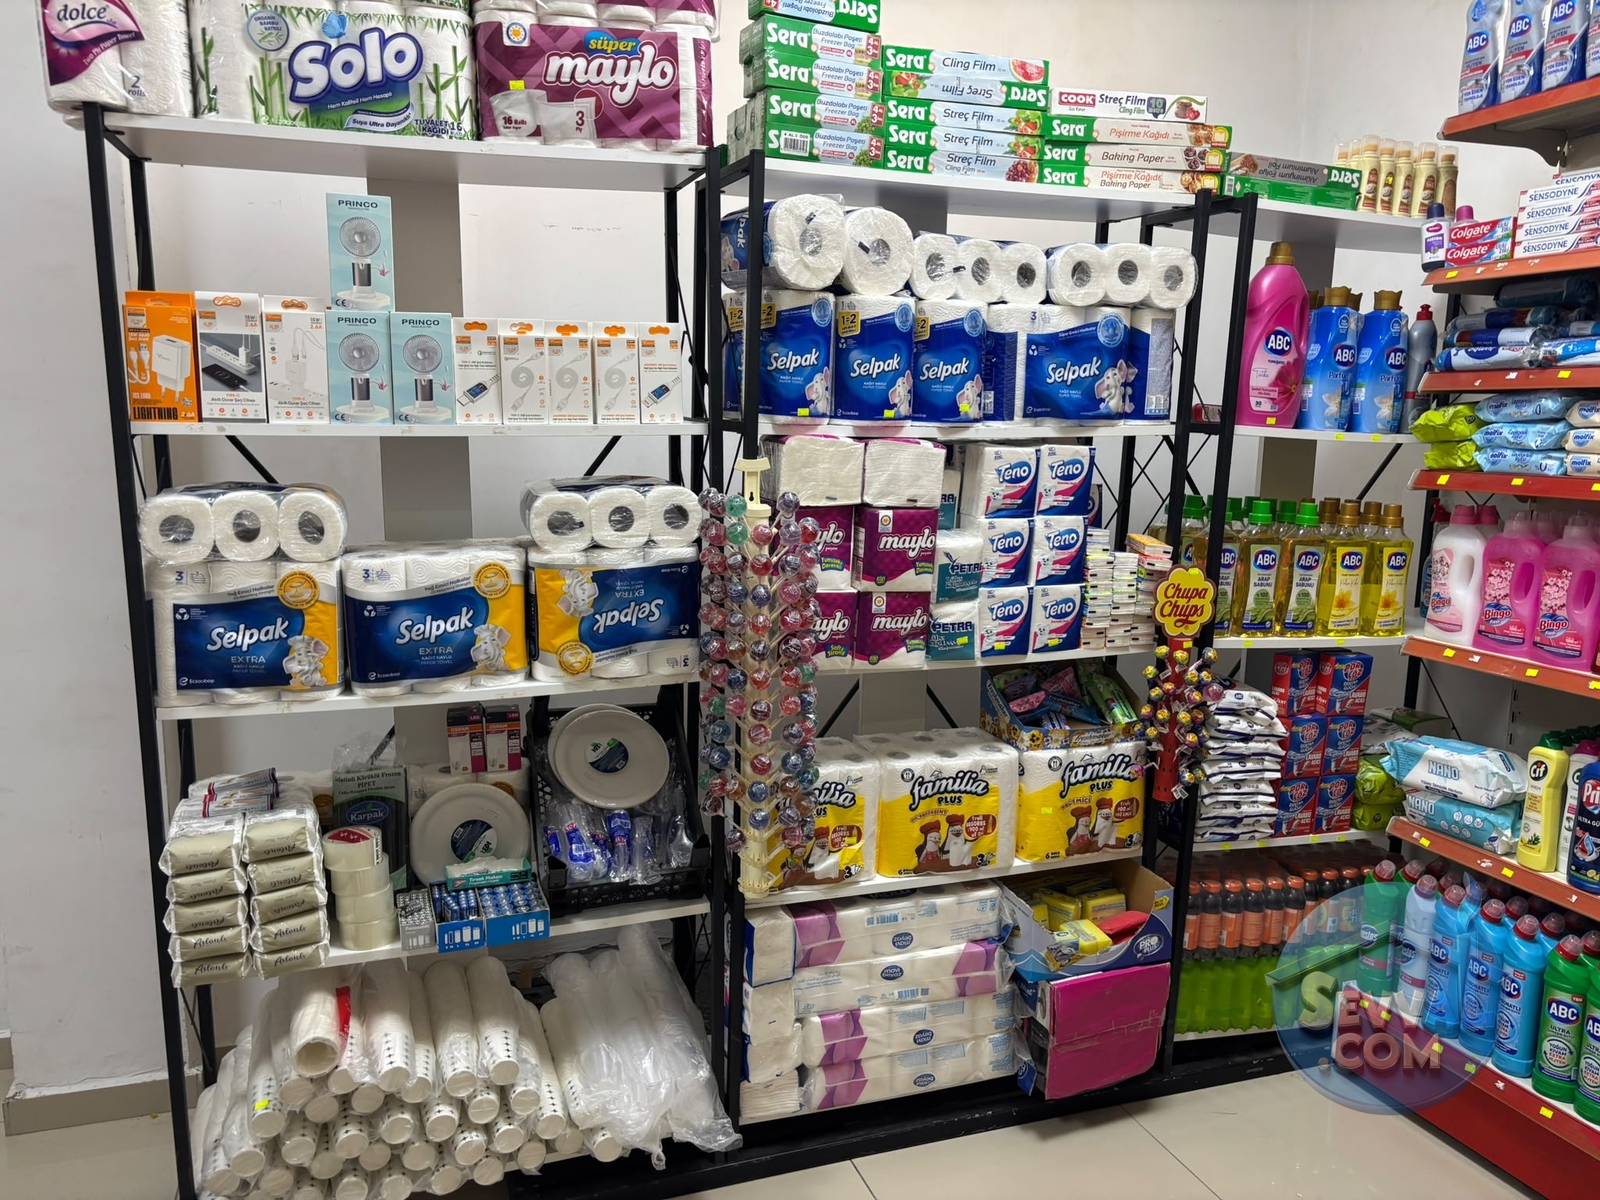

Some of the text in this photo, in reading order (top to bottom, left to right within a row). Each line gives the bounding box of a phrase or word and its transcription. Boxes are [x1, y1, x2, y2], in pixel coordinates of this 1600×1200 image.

[56, 3, 107, 22] dolce
[839, 0, 878, 23] Sera
[1552, 1, 1572, 19] ABC
[813, 28, 843, 39] Buzdolabı
[1510, 18, 1529, 35] ABC
[766, 22, 808, 48] Sera
[820, 37, 842, 46] Freezer
[1467, 34, 1487, 50] ABC
[588, 36, 636, 52] süper
[886, 49, 924, 70] Sera
[942, 58, 996, 71] Cling Film
[546, 43, 675, 104] maylo
[768, 58, 810, 83] Sera
[814, 63, 844, 73] Buzdolabı
[131, 76, 140, 88] 2
[822, 72, 842, 81] Freezer
[942, 84, 993, 99] Streç Film
[1010, 87, 1046, 107] Sera
[816, 98, 848, 108] Buzdolabı
[1060, 94, 1095, 104] COOK
[1099, 94, 1146, 106] Streç Film
[769, 95, 812, 118] Sera
[825, 107, 846, 115] Freezer
[888, 100, 926, 121] Sera
[1118, 107, 1132, 115] Cling
[502, 116, 513, 125] 16
[576, 110, 584, 126] 3
[943, 109, 994, 122] Streç Film
[352, 118, 384, 128] Suya Ultra
[414, 118, 448, 128] TUVALET
[450, 121, 462, 132] 16
[1052, 120, 1085, 137] Sera
[422, 126, 450, 136] KAĞIDI
[815, 133, 845, 142] Buzdolabı
[889, 125, 927, 145] Sera
[1110, 128, 1170, 140] Pişirme Kağıdı
[823, 141, 844, 150] Freezer
[944, 133, 993, 146] Streç Film
[887, 150, 924, 170] Sera
[946, 153, 996, 166] Streç Film
[1044, 145, 1077, 161] Sera
[1102, 152, 1165, 165] Baking Paper
[1043, 168, 1076, 185] Sera
[1101, 171, 1161, 182] Pişirme Kağıdı
[1330, 169, 1361, 188] Sera
[1100, 180, 1150, 190] Baking Paper
[1529, 187, 1579, 202] SENSODYNE
[338, 200, 378, 208] PRINCO
[1527, 204, 1573, 219] SENSODYNE
[1451, 224, 1490, 239] Colgate
[1525, 222, 1569, 236] SENSODYNE
[1447, 245, 1488, 260] Colgate
[1523, 240, 1568, 254] SENSODYNE
[841, 313, 856, 325] 1=2
[1031, 312, 1037, 320] 3
[1268, 336, 1290, 351] ABC
[767, 349, 819, 372] Selpak
[1336, 350, 1354, 362] ABC
[1388, 353, 1406, 364] ABC
[850, 353, 900, 378] Selpak
[920, 357, 970, 382] Selpak
[1047, 356, 1101, 384] Selpak
[133, 406, 178, 420] LIGHTNING
[1579, 406, 1600, 414] molfix
[1052, 461, 1082, 479] Teno
[1571, 459, 1592, 467] molfix
[1000, 461, 1028, 483] Teno
[879, 528, 936, 559] maylo
[991, 533, 1022, 553] Teno
[1048, 531, 1077, 549] Teno
[1256, 554, 1275, 565] ABC
[1299, 555, 1318, 566] ABC
[1344, 555, 1362, 566] ABC
[1390, 556, 1406, 566] ABC
[176, 572, 183, 581] 3
[362, 568, 370, 578] 3
[615, 589, 644, 598] EXTRA
[1164, 583, 1208, 604] Chupa
[1045, 601, 1074, 619] Teno
[1431, 598, 1450, 608] Bingo
[594, 599, 663, 634] Selpak
[991, 603, 1022, 621] Teno
[1160, 600, 1205, 624] Chups
[1484, 609, 1511, 620] Bingo
[396, 607, 474, 645] Selpak
[873, 609, 928, 635] maylo
[934, 621, 972, 633] PETRA
[1540, 619, 1567, 630] Bingo
[206, 616, 289, 651] Selpak
[986, 683, 1009, 718] freshmaker
[1075, 732, 1111, 742] freshmaker
[1428, 760, 1460, 779] NANO
[1530, 763, 1547, 777] Cif
[356, 773, 380, 781] Körüklü
[358, 780, 376, 788] PİPET
[909, 770, 990, 810] familia
[1090, 781, 1113, 792] PLUS
[1583, 784, 1600, 802] Pri
[938, 796, 962, 804] PLUS
[1407, 794, 1435, 815] NANO
[350, 810, 384, 822] Karpak
[1140, 936, 1158, 950] PRO
[1469, 959, 1486, 977] ABC
[1550, 1002, 1577, 1020] ABC
[1550, 1025, 1571, 1035] ULTRA
[1549, 1047, 1566, 1056] KIVAM
[1550, 1042, 1567, 1052] YOĞUN
